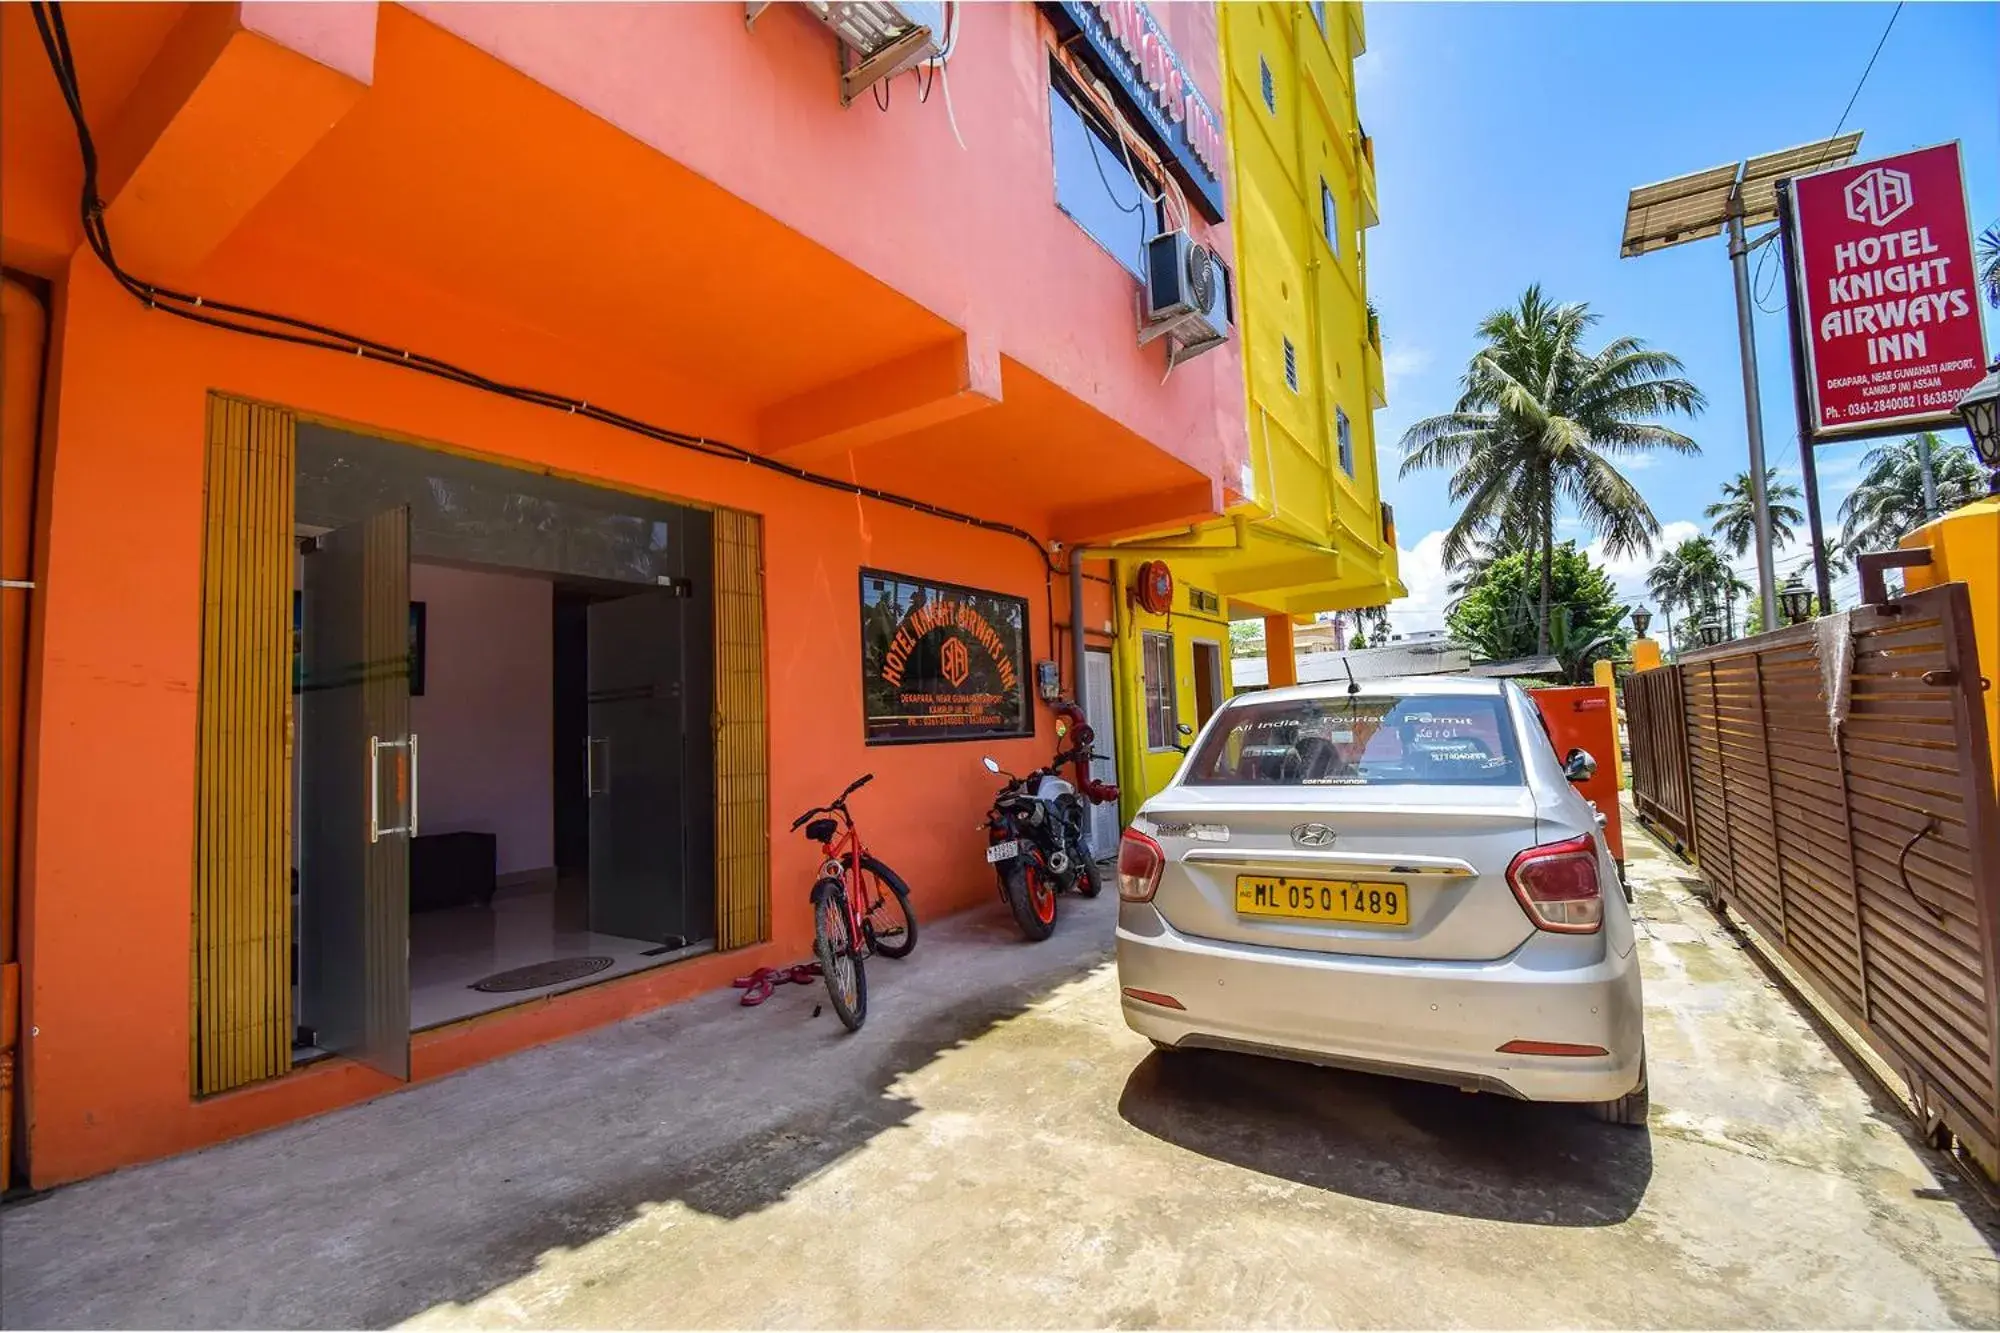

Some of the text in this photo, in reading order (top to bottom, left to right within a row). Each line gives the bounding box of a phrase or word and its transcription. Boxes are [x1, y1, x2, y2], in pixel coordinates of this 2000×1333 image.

[1834, 227, 1938, 274] HOTEL
[1829, 257, 1950, 304] KNIGHT
[1821, 289, 1969, 342] AIRWAYS
[1867, 330, 1926, 365] INN
[1862, 384, 1897, 397] KAMRUP
[1913, 377, 1942, 389] ASSAM
[1871, 371, 1892, 383] NEAR
[1894, 364, 1938, 380] GUWAHATI
[1848, 396, 1915, 416] 0361-2840082
[881, 600, 1016, 691] HOTEL KNIGHT AIRWAYS INN
[1233, 714, 1473, 733] All India Tourist Permit
